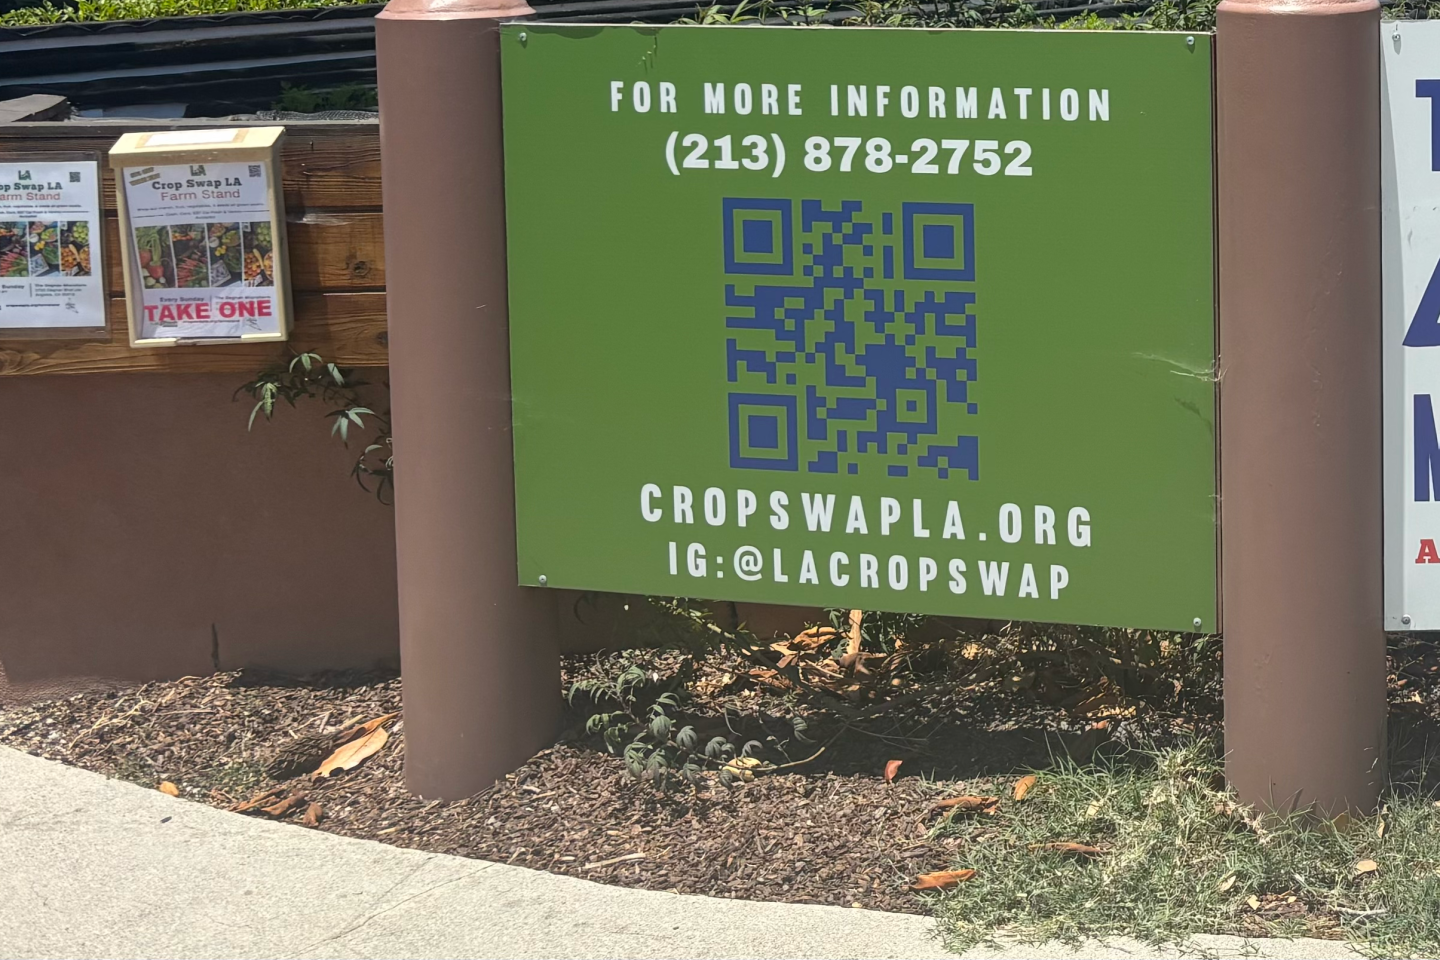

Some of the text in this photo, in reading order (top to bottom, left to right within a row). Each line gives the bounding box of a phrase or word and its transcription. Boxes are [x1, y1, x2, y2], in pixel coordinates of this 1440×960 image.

[610, 80, 1112, 122] FOR MORE INFORMATION
[665, 131, 1033, 177] (213) 878-2752
[14, 183, 44, 192] Swap
[47, 182, 63, 190] LA
[152, 178, 242, 190] Crop Swap LA
[26, 192, 60, 201] Stand
[161, 189, 240, 201] Farm Stand
[144, 300, 272, 321] TAKE ONE
[639, 482, 1093, 549] CROPSWAPLA.ORG
[668, 541, 1071, 600] IG:@LACROPSWAP
